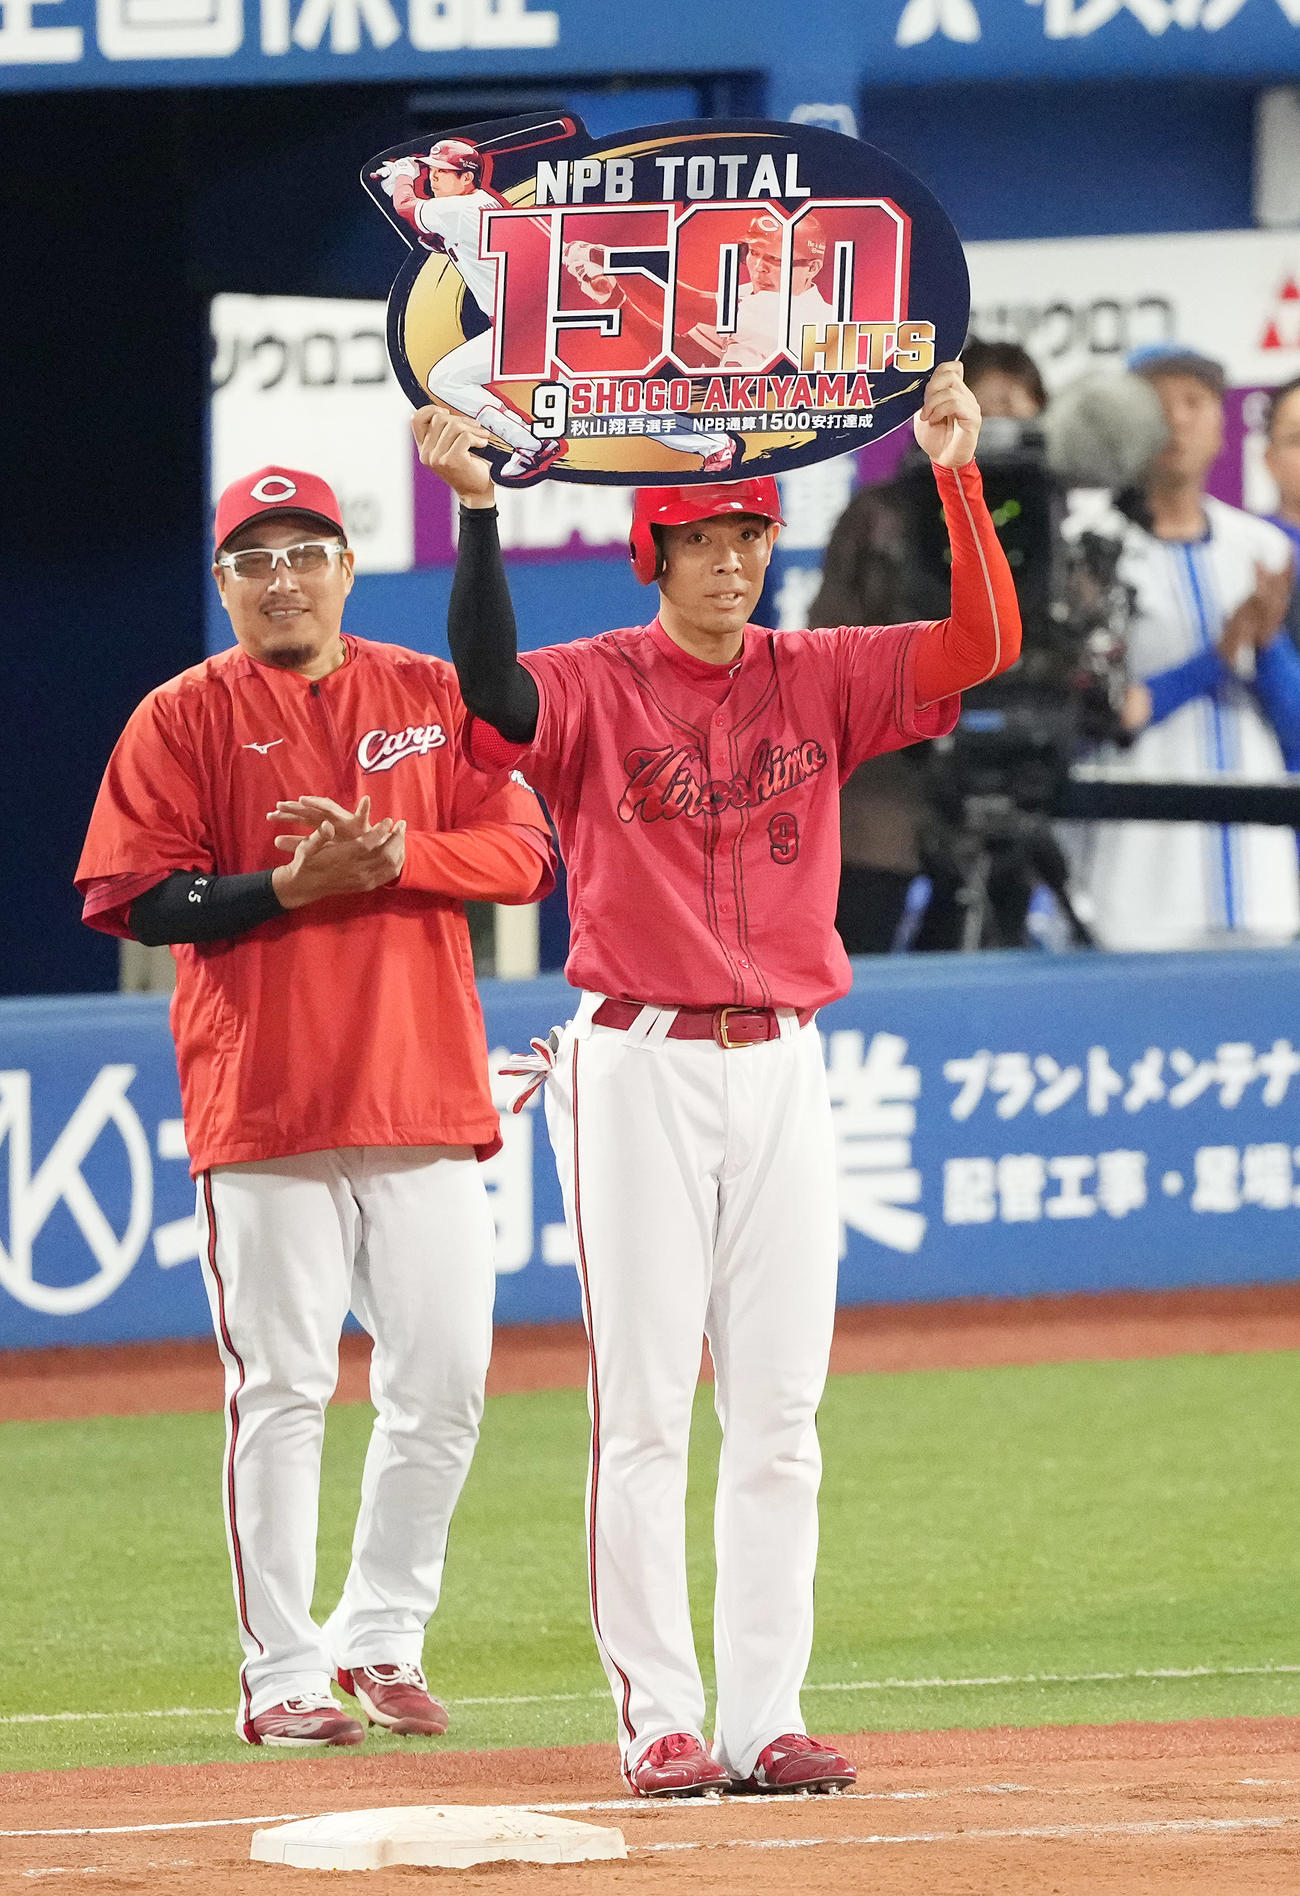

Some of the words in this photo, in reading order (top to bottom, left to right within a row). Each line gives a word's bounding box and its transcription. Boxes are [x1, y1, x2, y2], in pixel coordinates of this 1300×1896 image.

[537, 159, 634, 206] NPB
[655, 153, 812, 200] TOTAL
[479, 199, 910, 381] 1500
[798, 321, 936, 374] HITS
[531, 382, 569, 439] 9
[571, 378, 692, 416] SHOGO
[701, 374, 874, 412] AKIYAMA
[570, 417, 677, 437] 秋山翔吾選手
[692, 412, 874, 432] NPB通算1500安打達成
[357, 724, 446, 774] Carp
[617, 739, 827, 823] Hiroshima
[767, 812, 799, 864] 9
